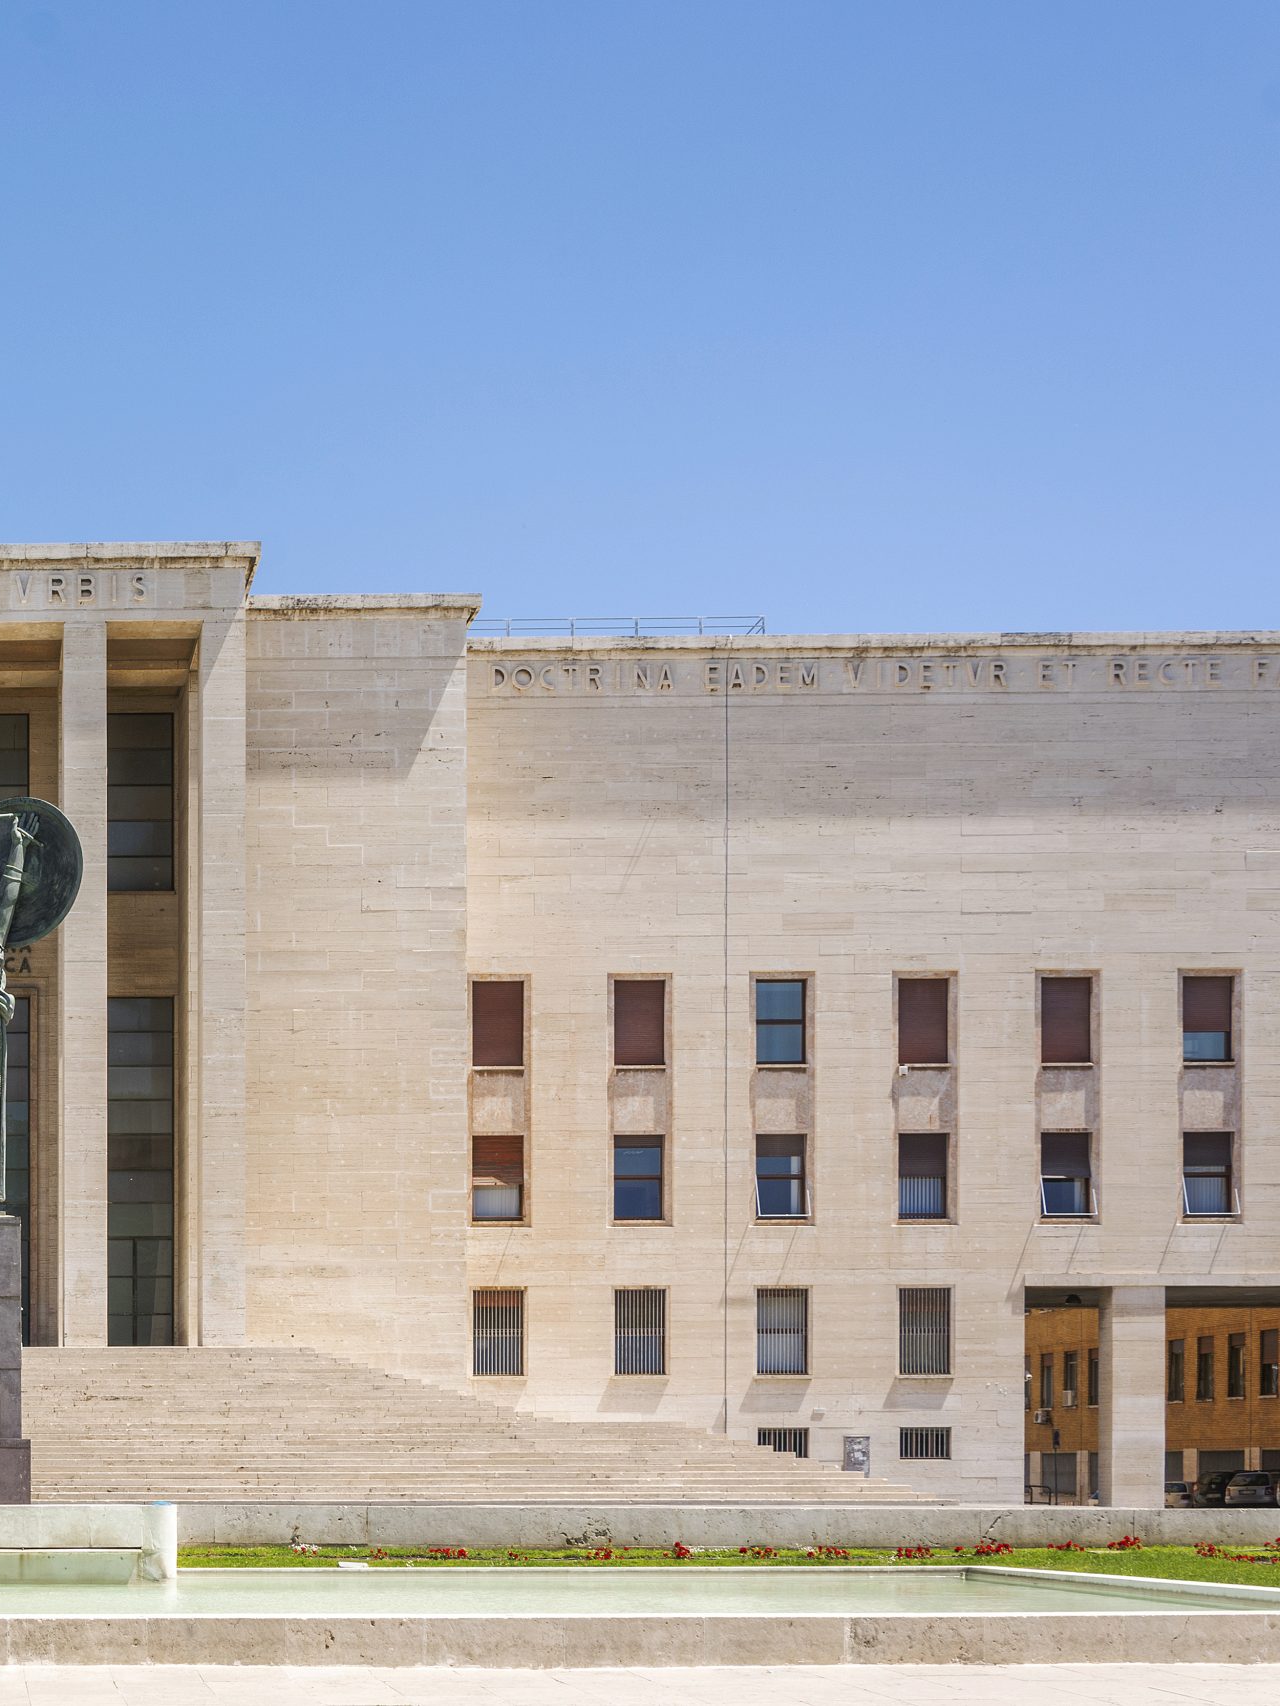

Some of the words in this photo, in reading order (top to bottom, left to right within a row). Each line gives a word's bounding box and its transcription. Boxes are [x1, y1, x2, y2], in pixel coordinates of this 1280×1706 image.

[16, 573, 148, 603] VRBIS
[490, 663, 673, 690] DOCTRINA
[704, 662, 818, 689] EADEM
[847, 660, 1008, 688] VIDETVR
[1037, 660, 1077, 688] ET
[1108, 659, 1223, 687] RECTE
